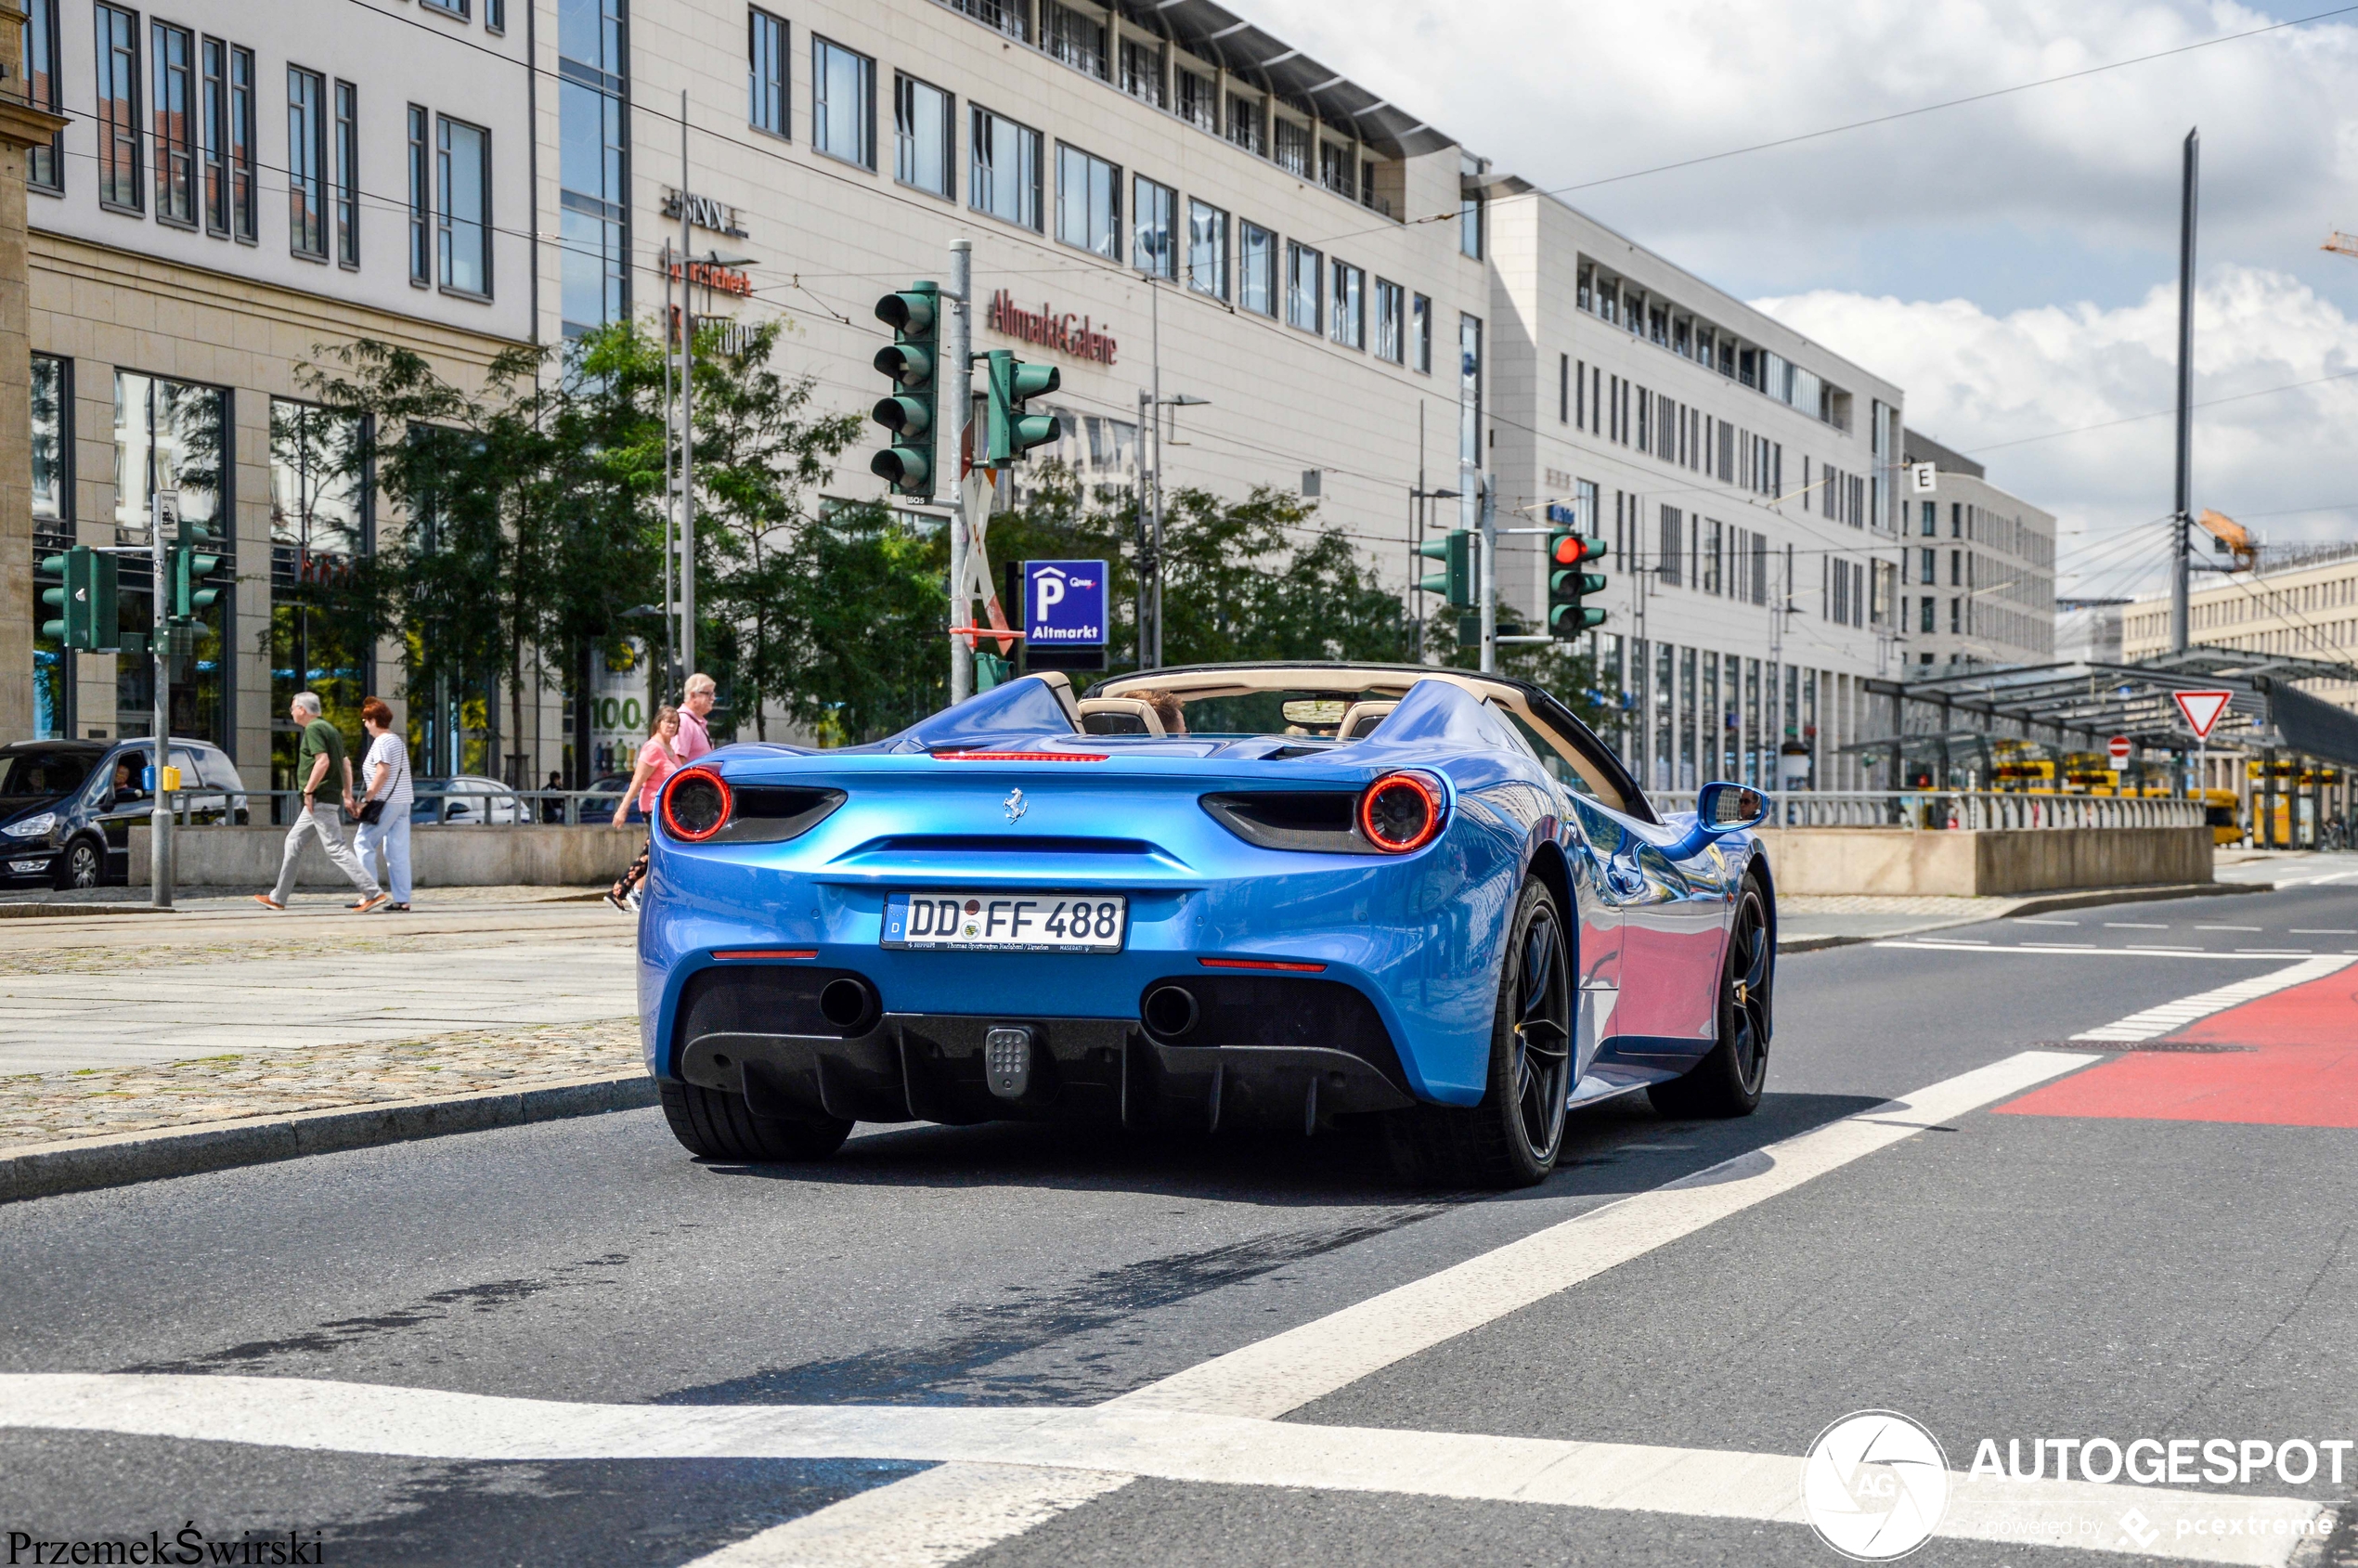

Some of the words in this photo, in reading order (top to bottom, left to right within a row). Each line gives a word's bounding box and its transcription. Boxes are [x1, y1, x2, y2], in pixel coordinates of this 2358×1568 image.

[990, 289, 1118, 366] Altmarkt-Galerie
[1919, 468, 1931, 487] E
[1037, 577, 1065, 622] P
[1031, 625, 1098, 640] Altmarkt
[890, 922, 900, 934] D
[909, 900, 961, 938] DD
[984, 901, 1038, 938] FF
[1044, 901, 1118, 940] 488
[947, 941, 967, 950] Thomas
